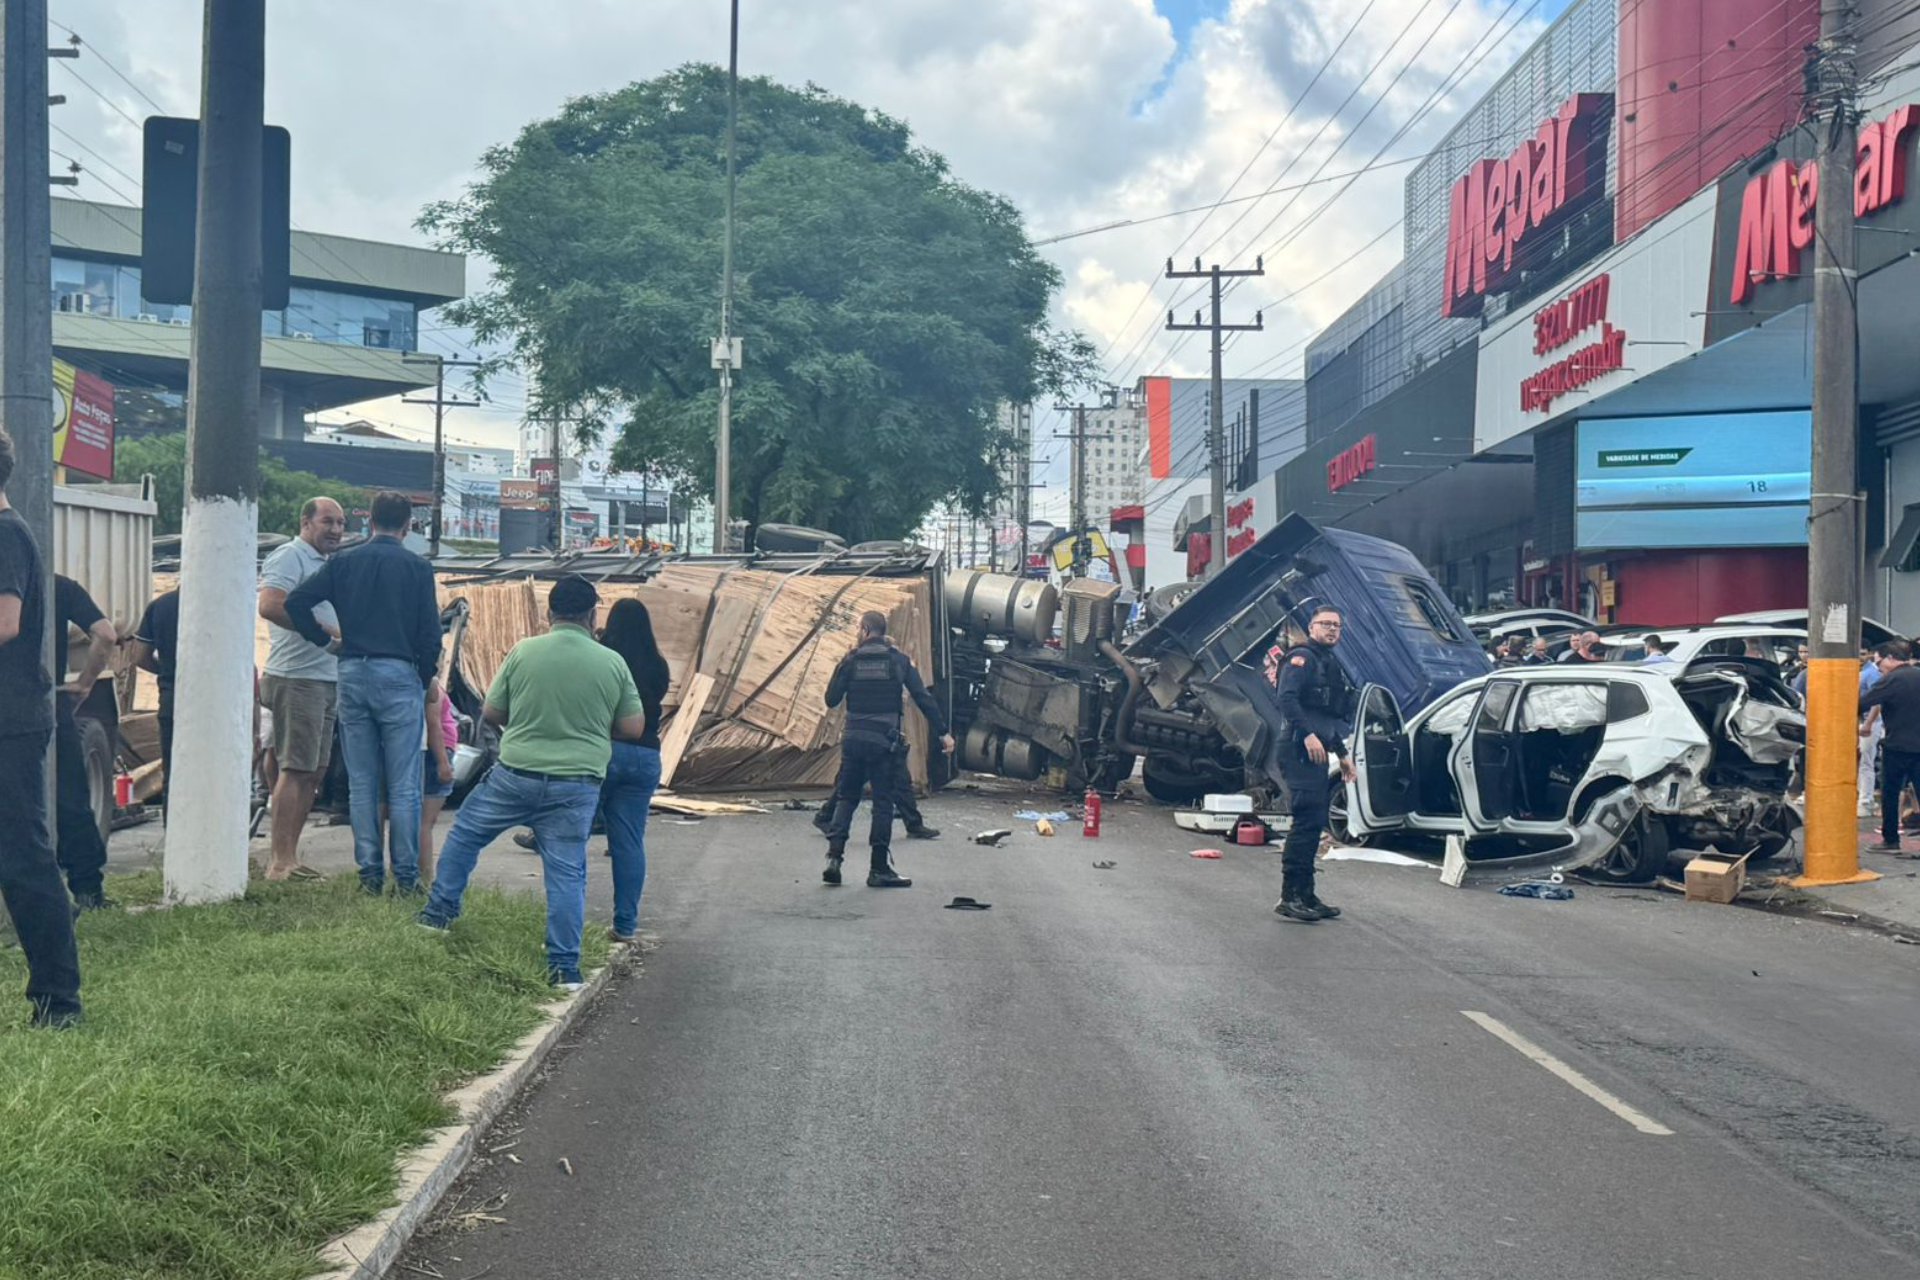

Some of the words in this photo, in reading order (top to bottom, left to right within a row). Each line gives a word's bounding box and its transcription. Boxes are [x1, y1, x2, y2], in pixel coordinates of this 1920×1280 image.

[1441, 93, 1579, 318] Mepar
[1730, 104, 1914, 304] Mear
[1520, 322, 1626, 413] mepar.com.br
[1605, 454, 1639, 462] VARIEDADE
[1640, 453, 1649, 461] DE
[1650, 452, 1679, 460] MEDIDAS
[502, 486, 534, 499] Jeep
[1746, 480, 1768, 494] 18
